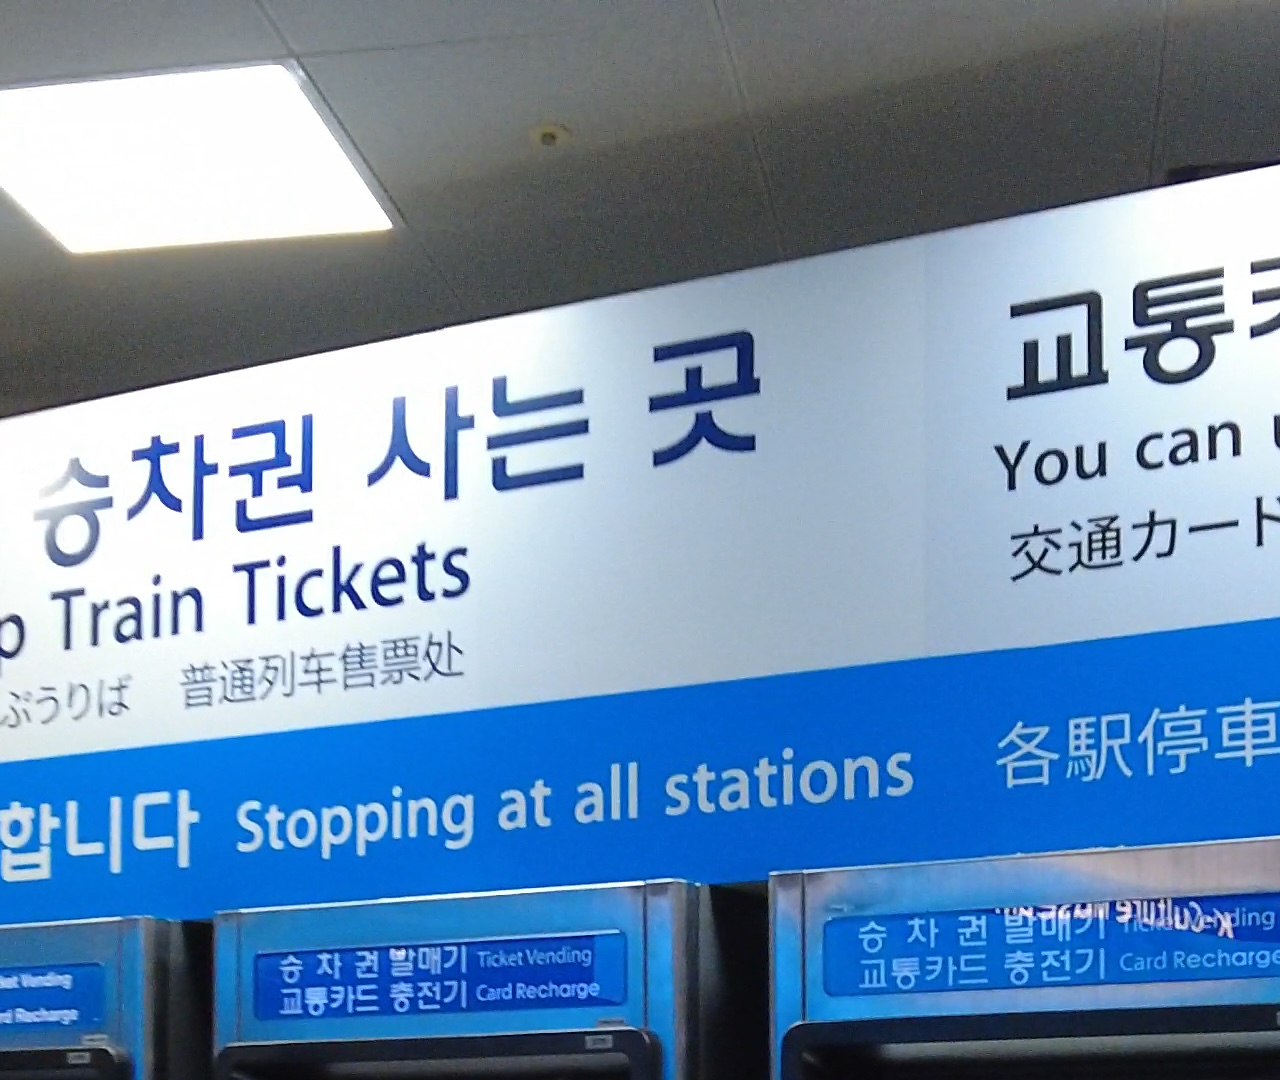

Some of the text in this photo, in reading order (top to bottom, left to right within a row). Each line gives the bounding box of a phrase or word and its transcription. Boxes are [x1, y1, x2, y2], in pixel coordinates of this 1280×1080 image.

[33, 412, 314, 567] 승차권
[367, 376, 589, 500] 사는
[649, 330, 760, 467] 곳
[994, 440, 1107, 491] You
[1136, 419, 1242, 470] can
[50, 575, 203, 651] Train
[234, 541, 471, 625] Tickets
[180, 631, 464, 709] 普通列车售票处
[236, 746, 915, 860] Stopping at all stations
[389, 945, 467, 977] 발매기
[477, 946, 592, 968] Ticket Vending
[858, 948, 1106, 990] 교통카드 충전기
[1119, 951, 1167, 972] Card
[279, 980, 467, 1016] 교통카드 충전기
[476, 981, 600, 1001] Card Recharge
